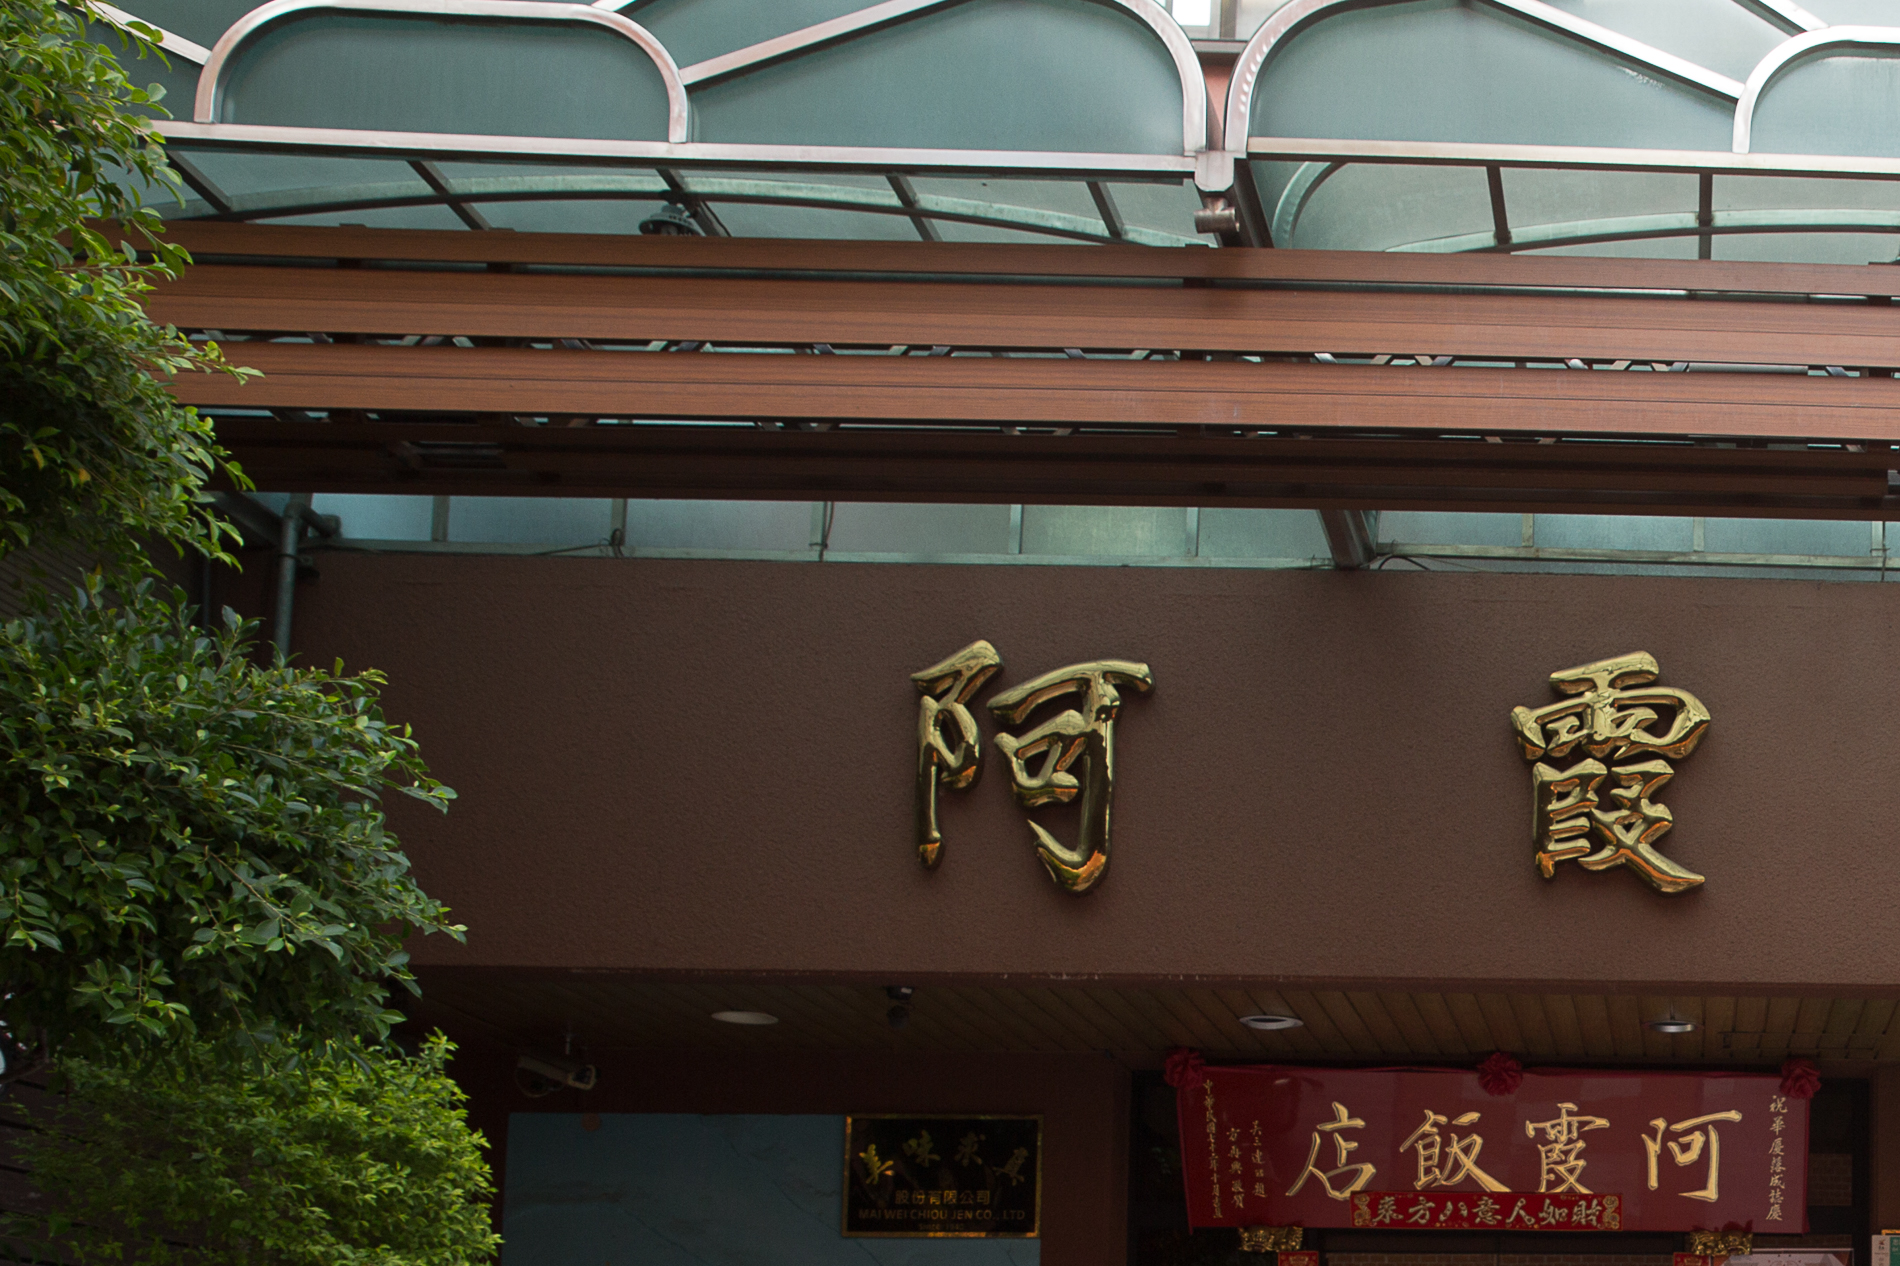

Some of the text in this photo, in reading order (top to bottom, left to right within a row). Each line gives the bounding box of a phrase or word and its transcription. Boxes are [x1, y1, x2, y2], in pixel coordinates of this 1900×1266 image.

[1286, 1101, 1742, 1202] 阿霞飯店
[895, 1190, 990, 1206] 股份有限公司
[858, 1209, 882, 1221] MAI
[884, 1209, 905, 1221] WEI
[909, 1209, 948, 1220] CHIOU
[950, 1209, 973, 1220] JEN
